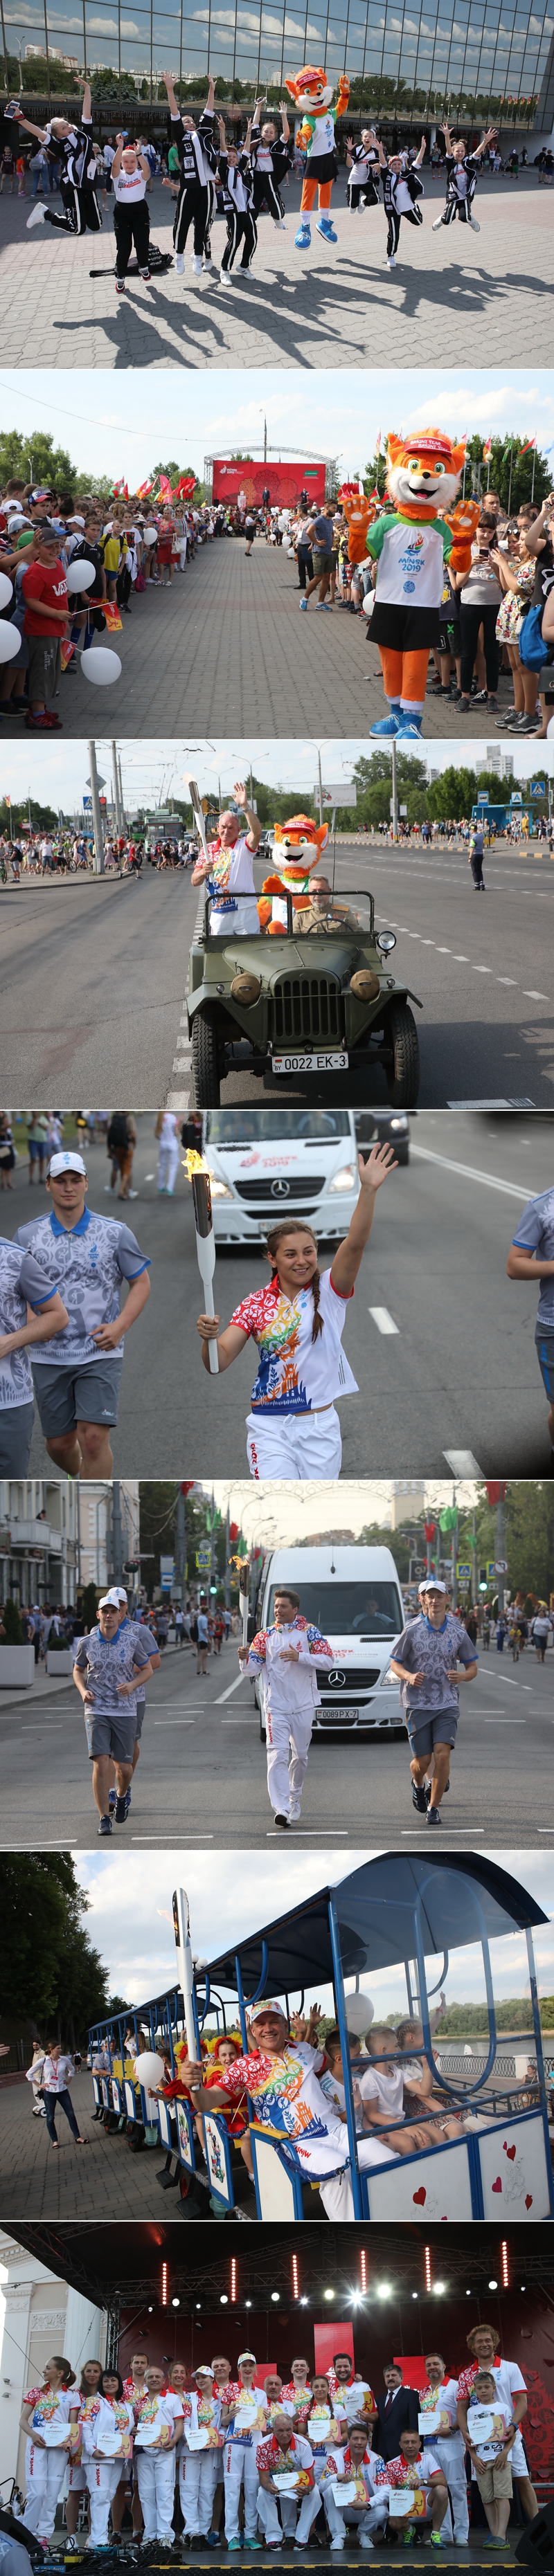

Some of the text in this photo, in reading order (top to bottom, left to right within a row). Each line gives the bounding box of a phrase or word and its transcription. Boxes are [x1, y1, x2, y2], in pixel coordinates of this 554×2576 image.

[402, 563, 421, 572] 2019
[52, 579, 68, 597] VAN
[285, 1055, 346, 1070] 0022 EK-3
